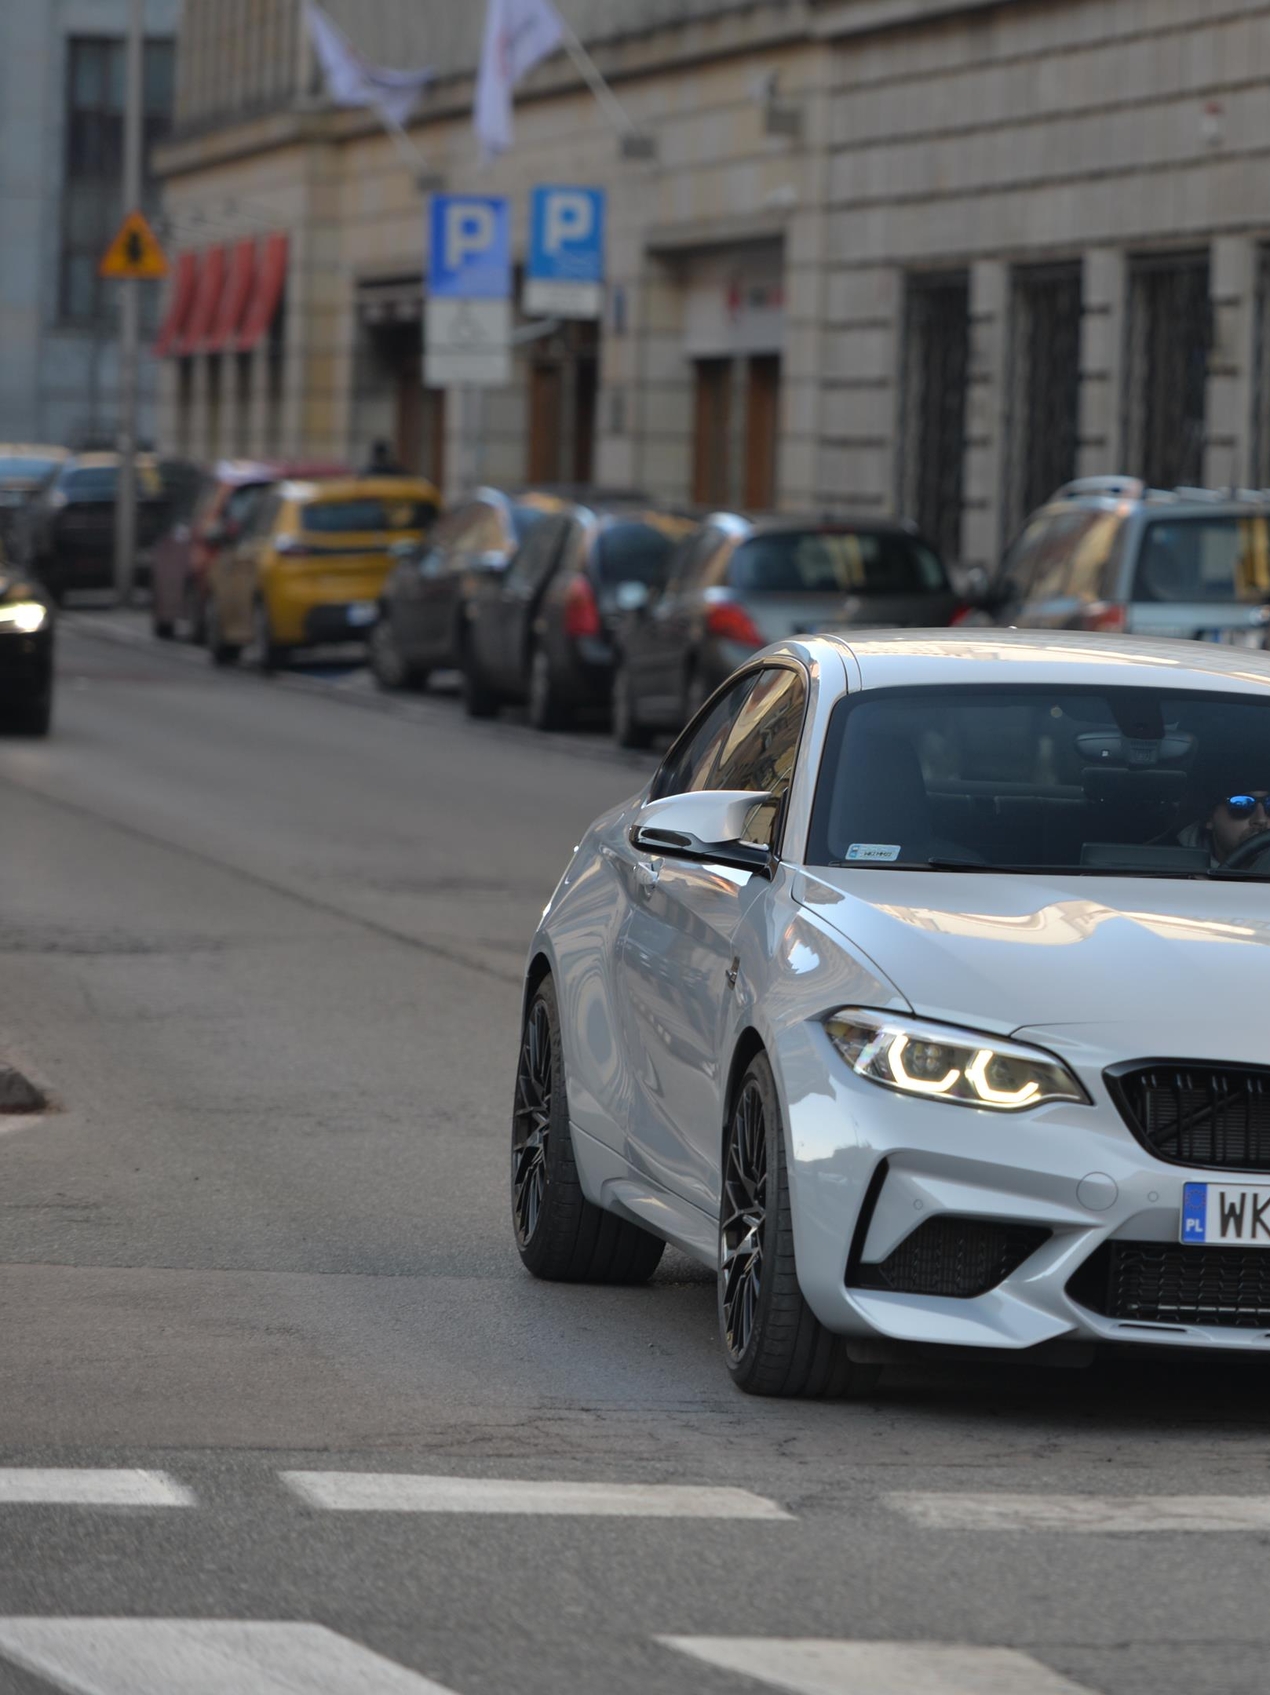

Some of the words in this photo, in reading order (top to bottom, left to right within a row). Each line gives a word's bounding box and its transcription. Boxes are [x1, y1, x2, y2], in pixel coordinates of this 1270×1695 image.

[446, 202, 496, 270] P
[545, 194, 595, 255] P
[1185, 1218, 1203, 1232] PL
